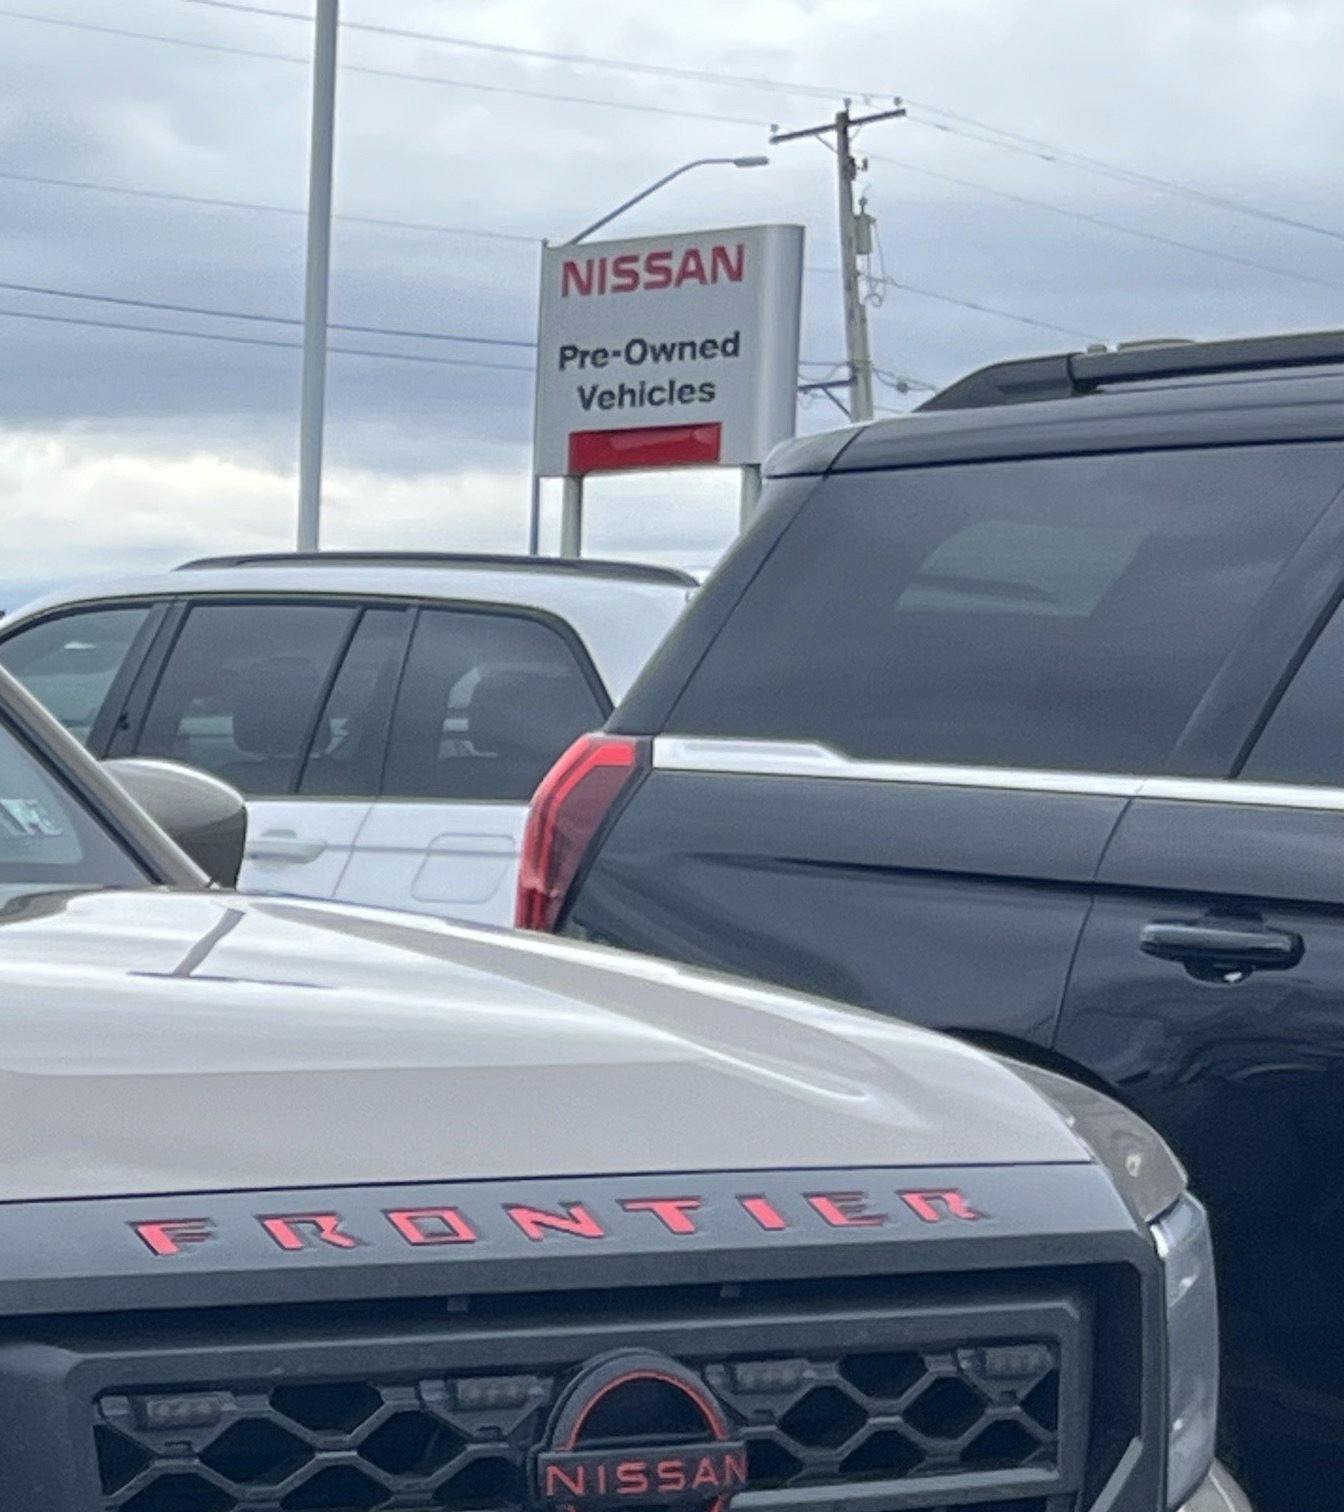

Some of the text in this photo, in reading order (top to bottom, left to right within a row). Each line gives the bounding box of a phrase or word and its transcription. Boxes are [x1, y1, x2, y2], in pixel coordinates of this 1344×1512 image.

[561, 243, 745, 298] NISSAN
[558, 331, 741, 372] Pre-Owned
[576, 379, 717, 412] Vehicles
[127, 1187, 989, 1257] FRONTIER
[544, 1453, 749, 1497] NISSAN
